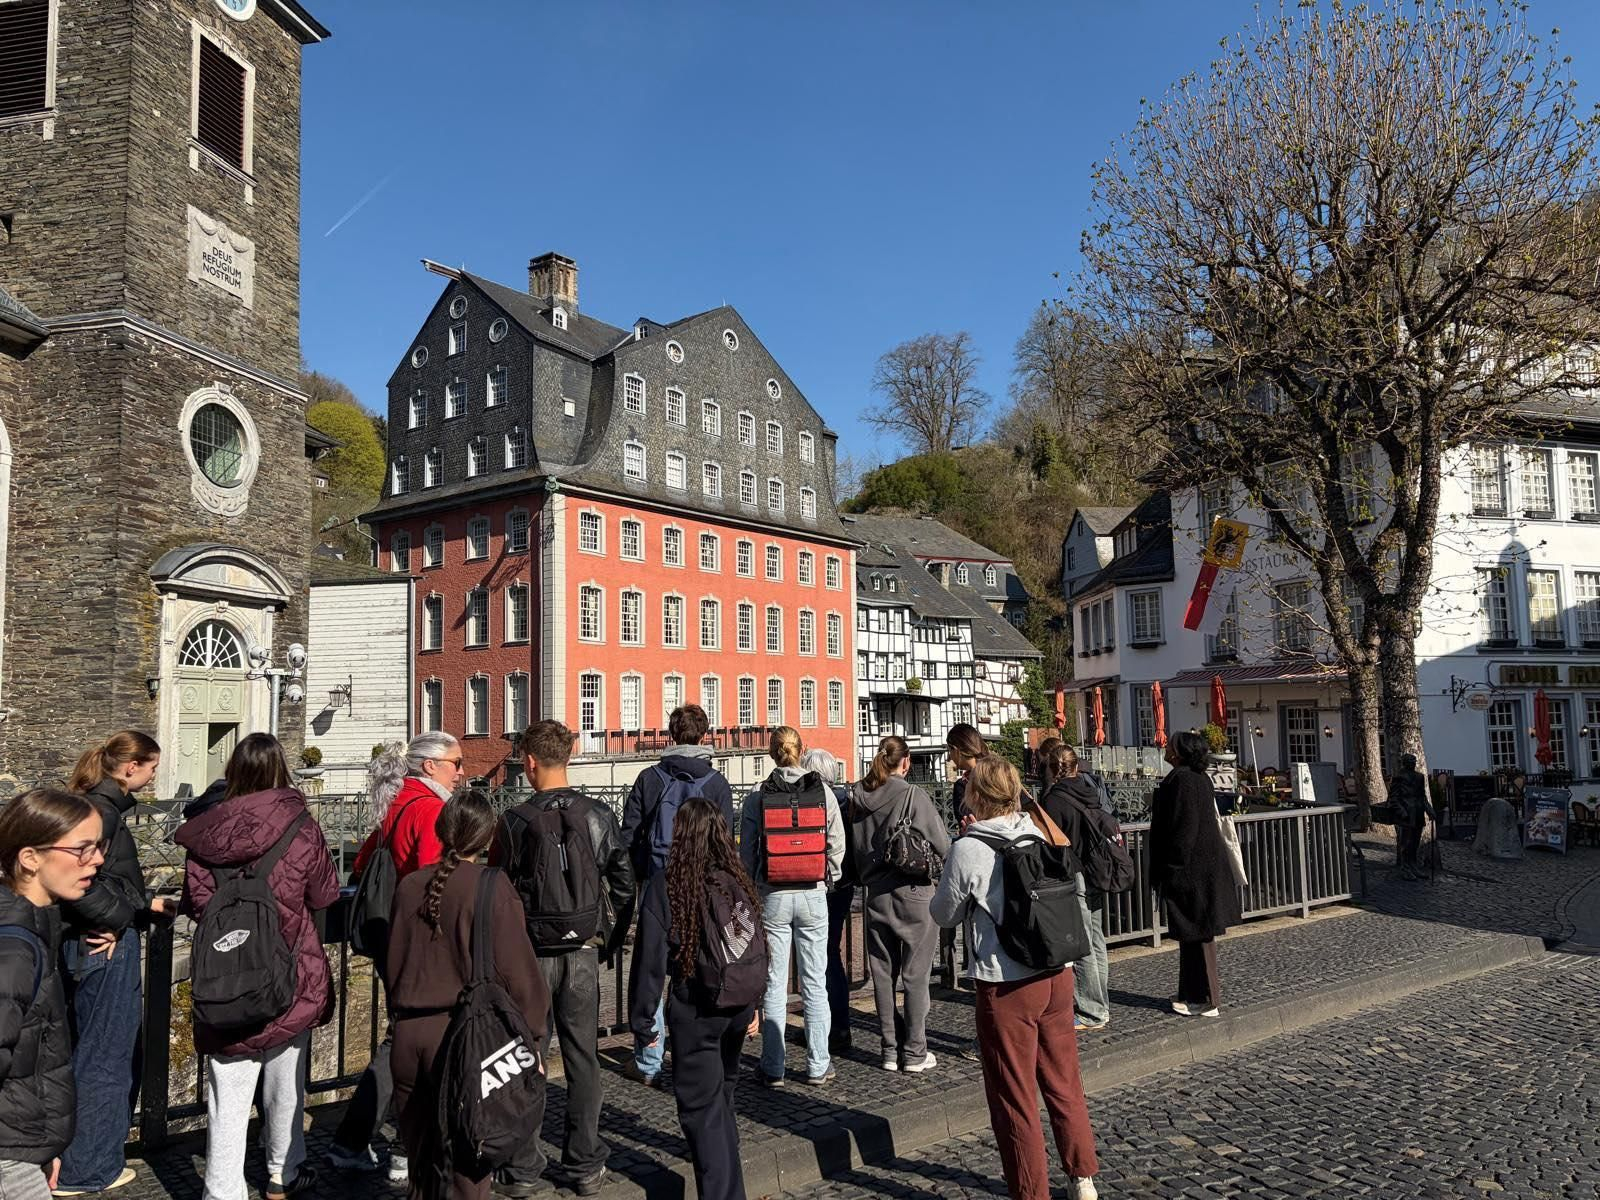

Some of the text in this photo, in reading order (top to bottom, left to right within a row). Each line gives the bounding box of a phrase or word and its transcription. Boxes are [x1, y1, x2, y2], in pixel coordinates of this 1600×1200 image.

[202, 252, 241, 279] REFUGIUM
[212, 247, 232, 264] DEUS
[202, 263, 240, 289] NOSTRUM
